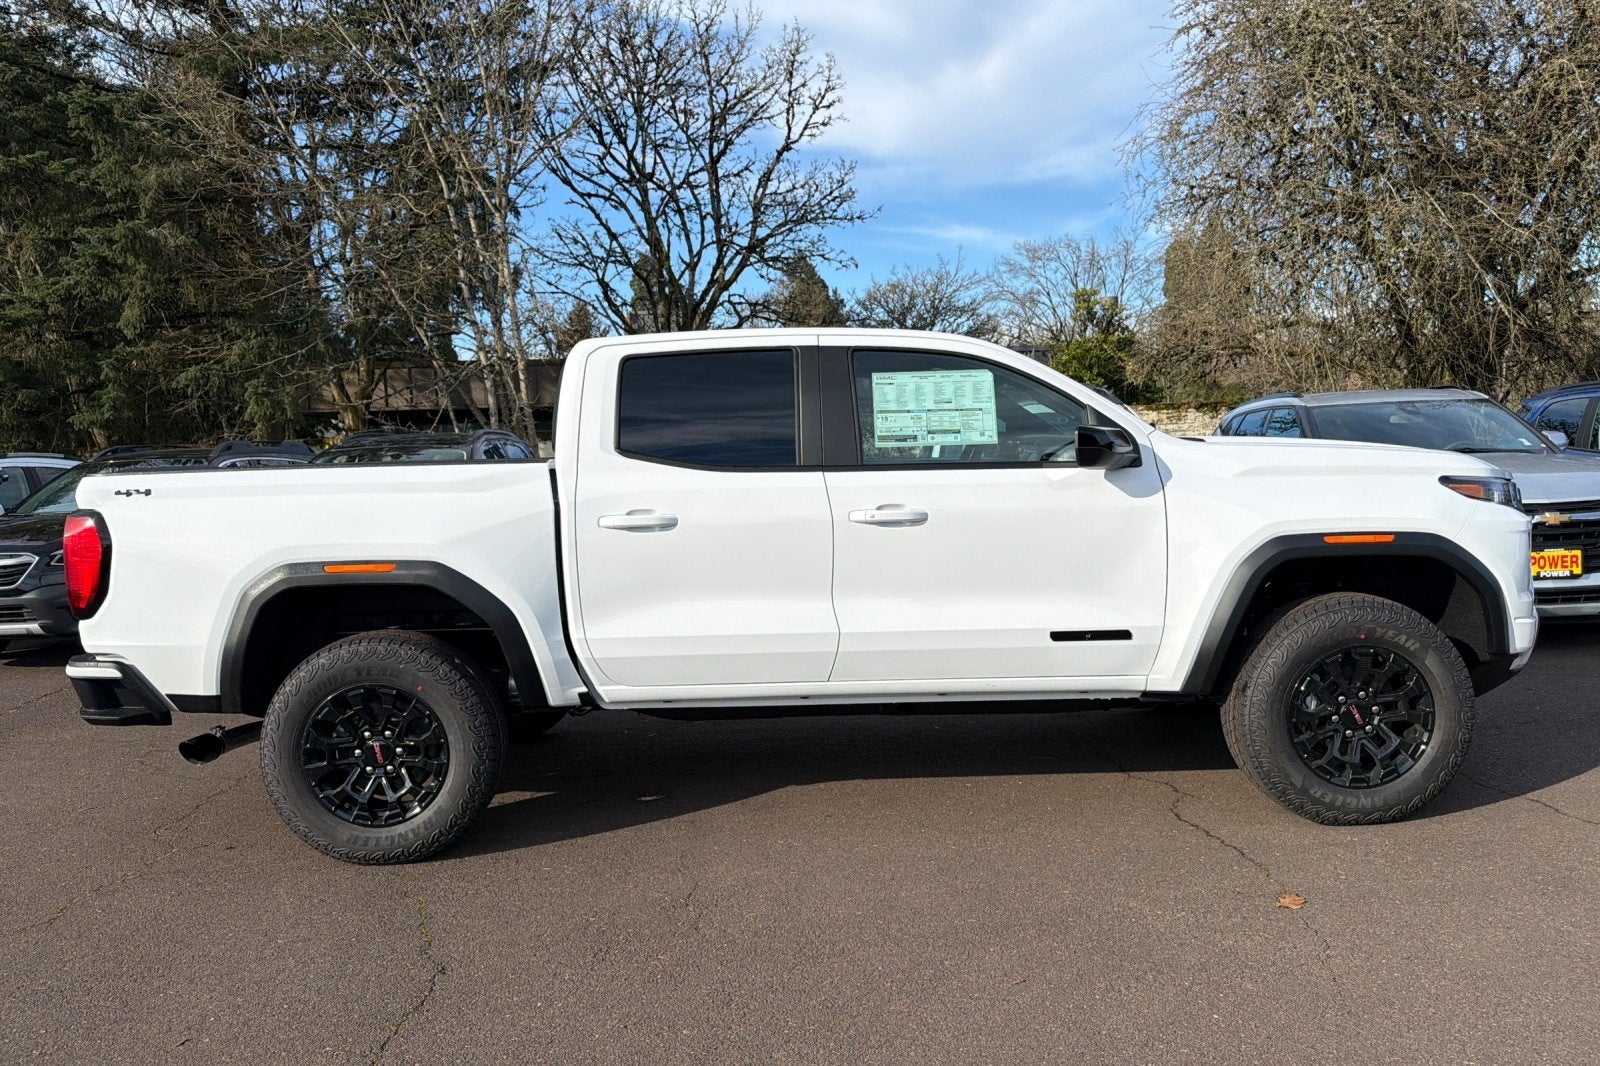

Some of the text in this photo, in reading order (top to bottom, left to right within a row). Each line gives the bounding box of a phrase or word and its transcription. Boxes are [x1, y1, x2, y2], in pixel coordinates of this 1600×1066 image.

[1530, 554, 1580, 570] POWER
[1540, 570, 1571, 578] POWER
[373, 741, 384, 764] GMC
